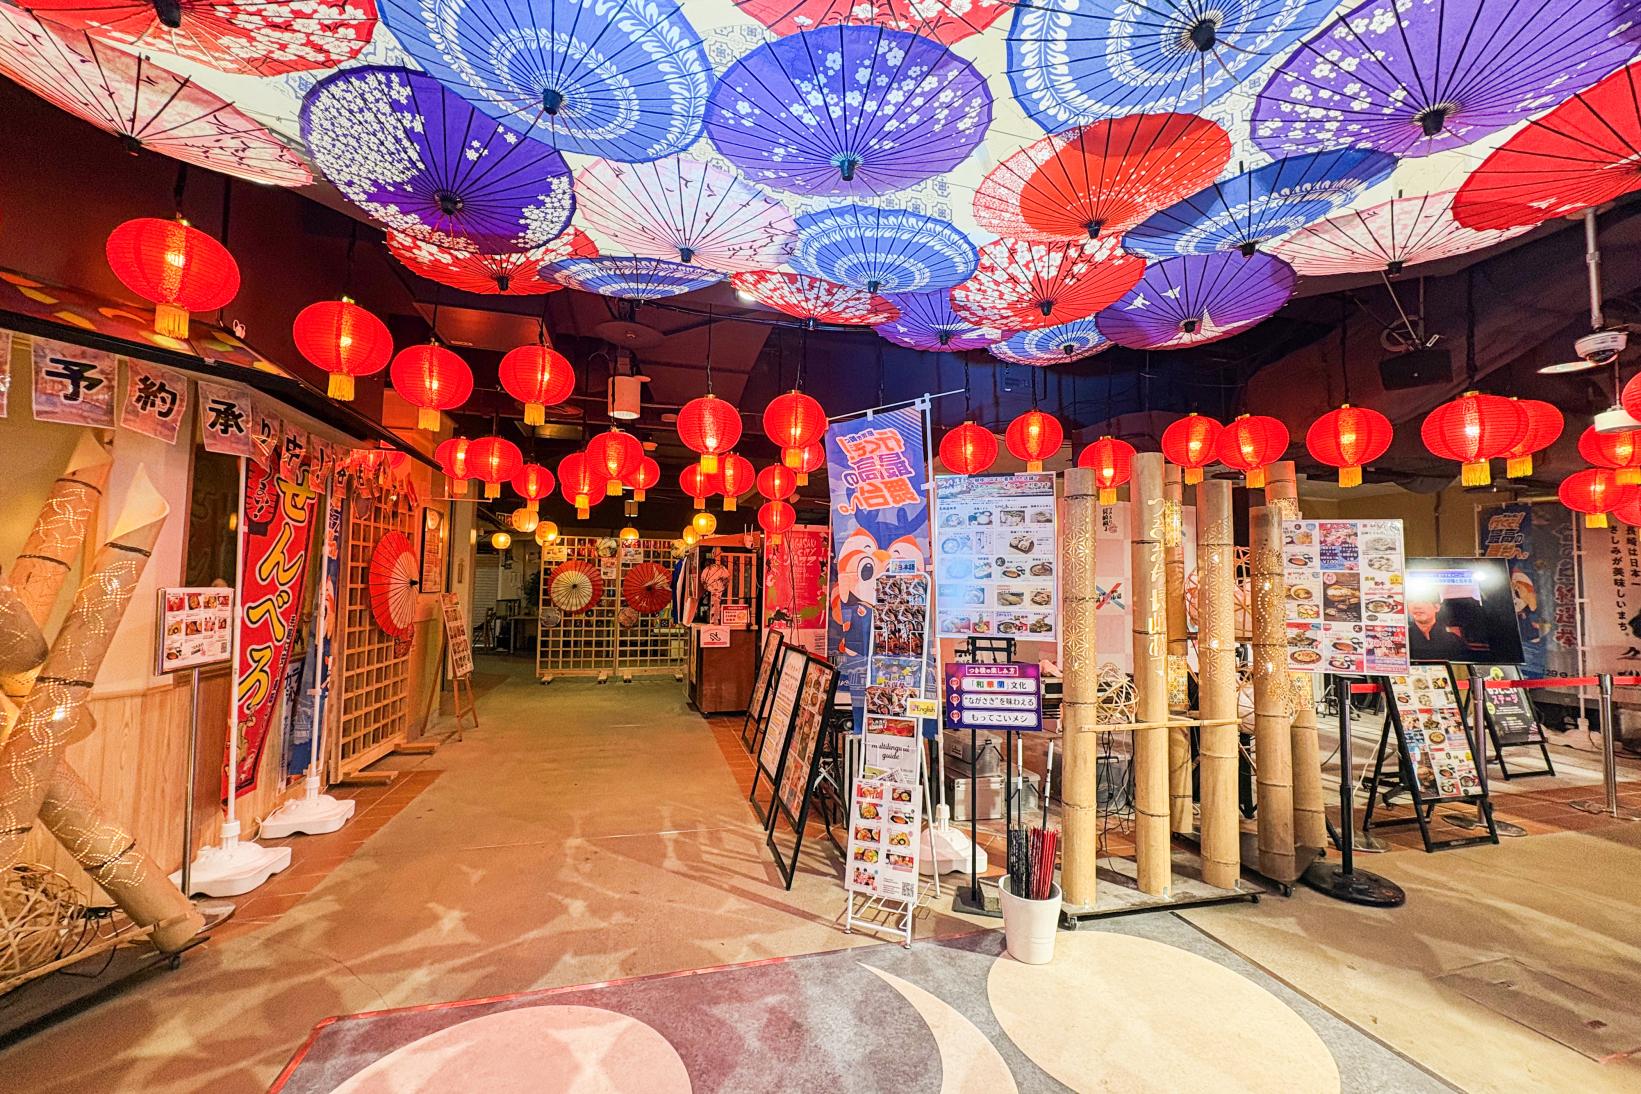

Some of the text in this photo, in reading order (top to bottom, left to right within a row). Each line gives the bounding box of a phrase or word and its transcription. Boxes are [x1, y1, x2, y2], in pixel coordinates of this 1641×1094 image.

[238, 466, 318, 714] せんべろ
[1610, 525, 1629, 637] さしみが美味しいまち。
[971, 713, 1028, 723] もってこいメシ
